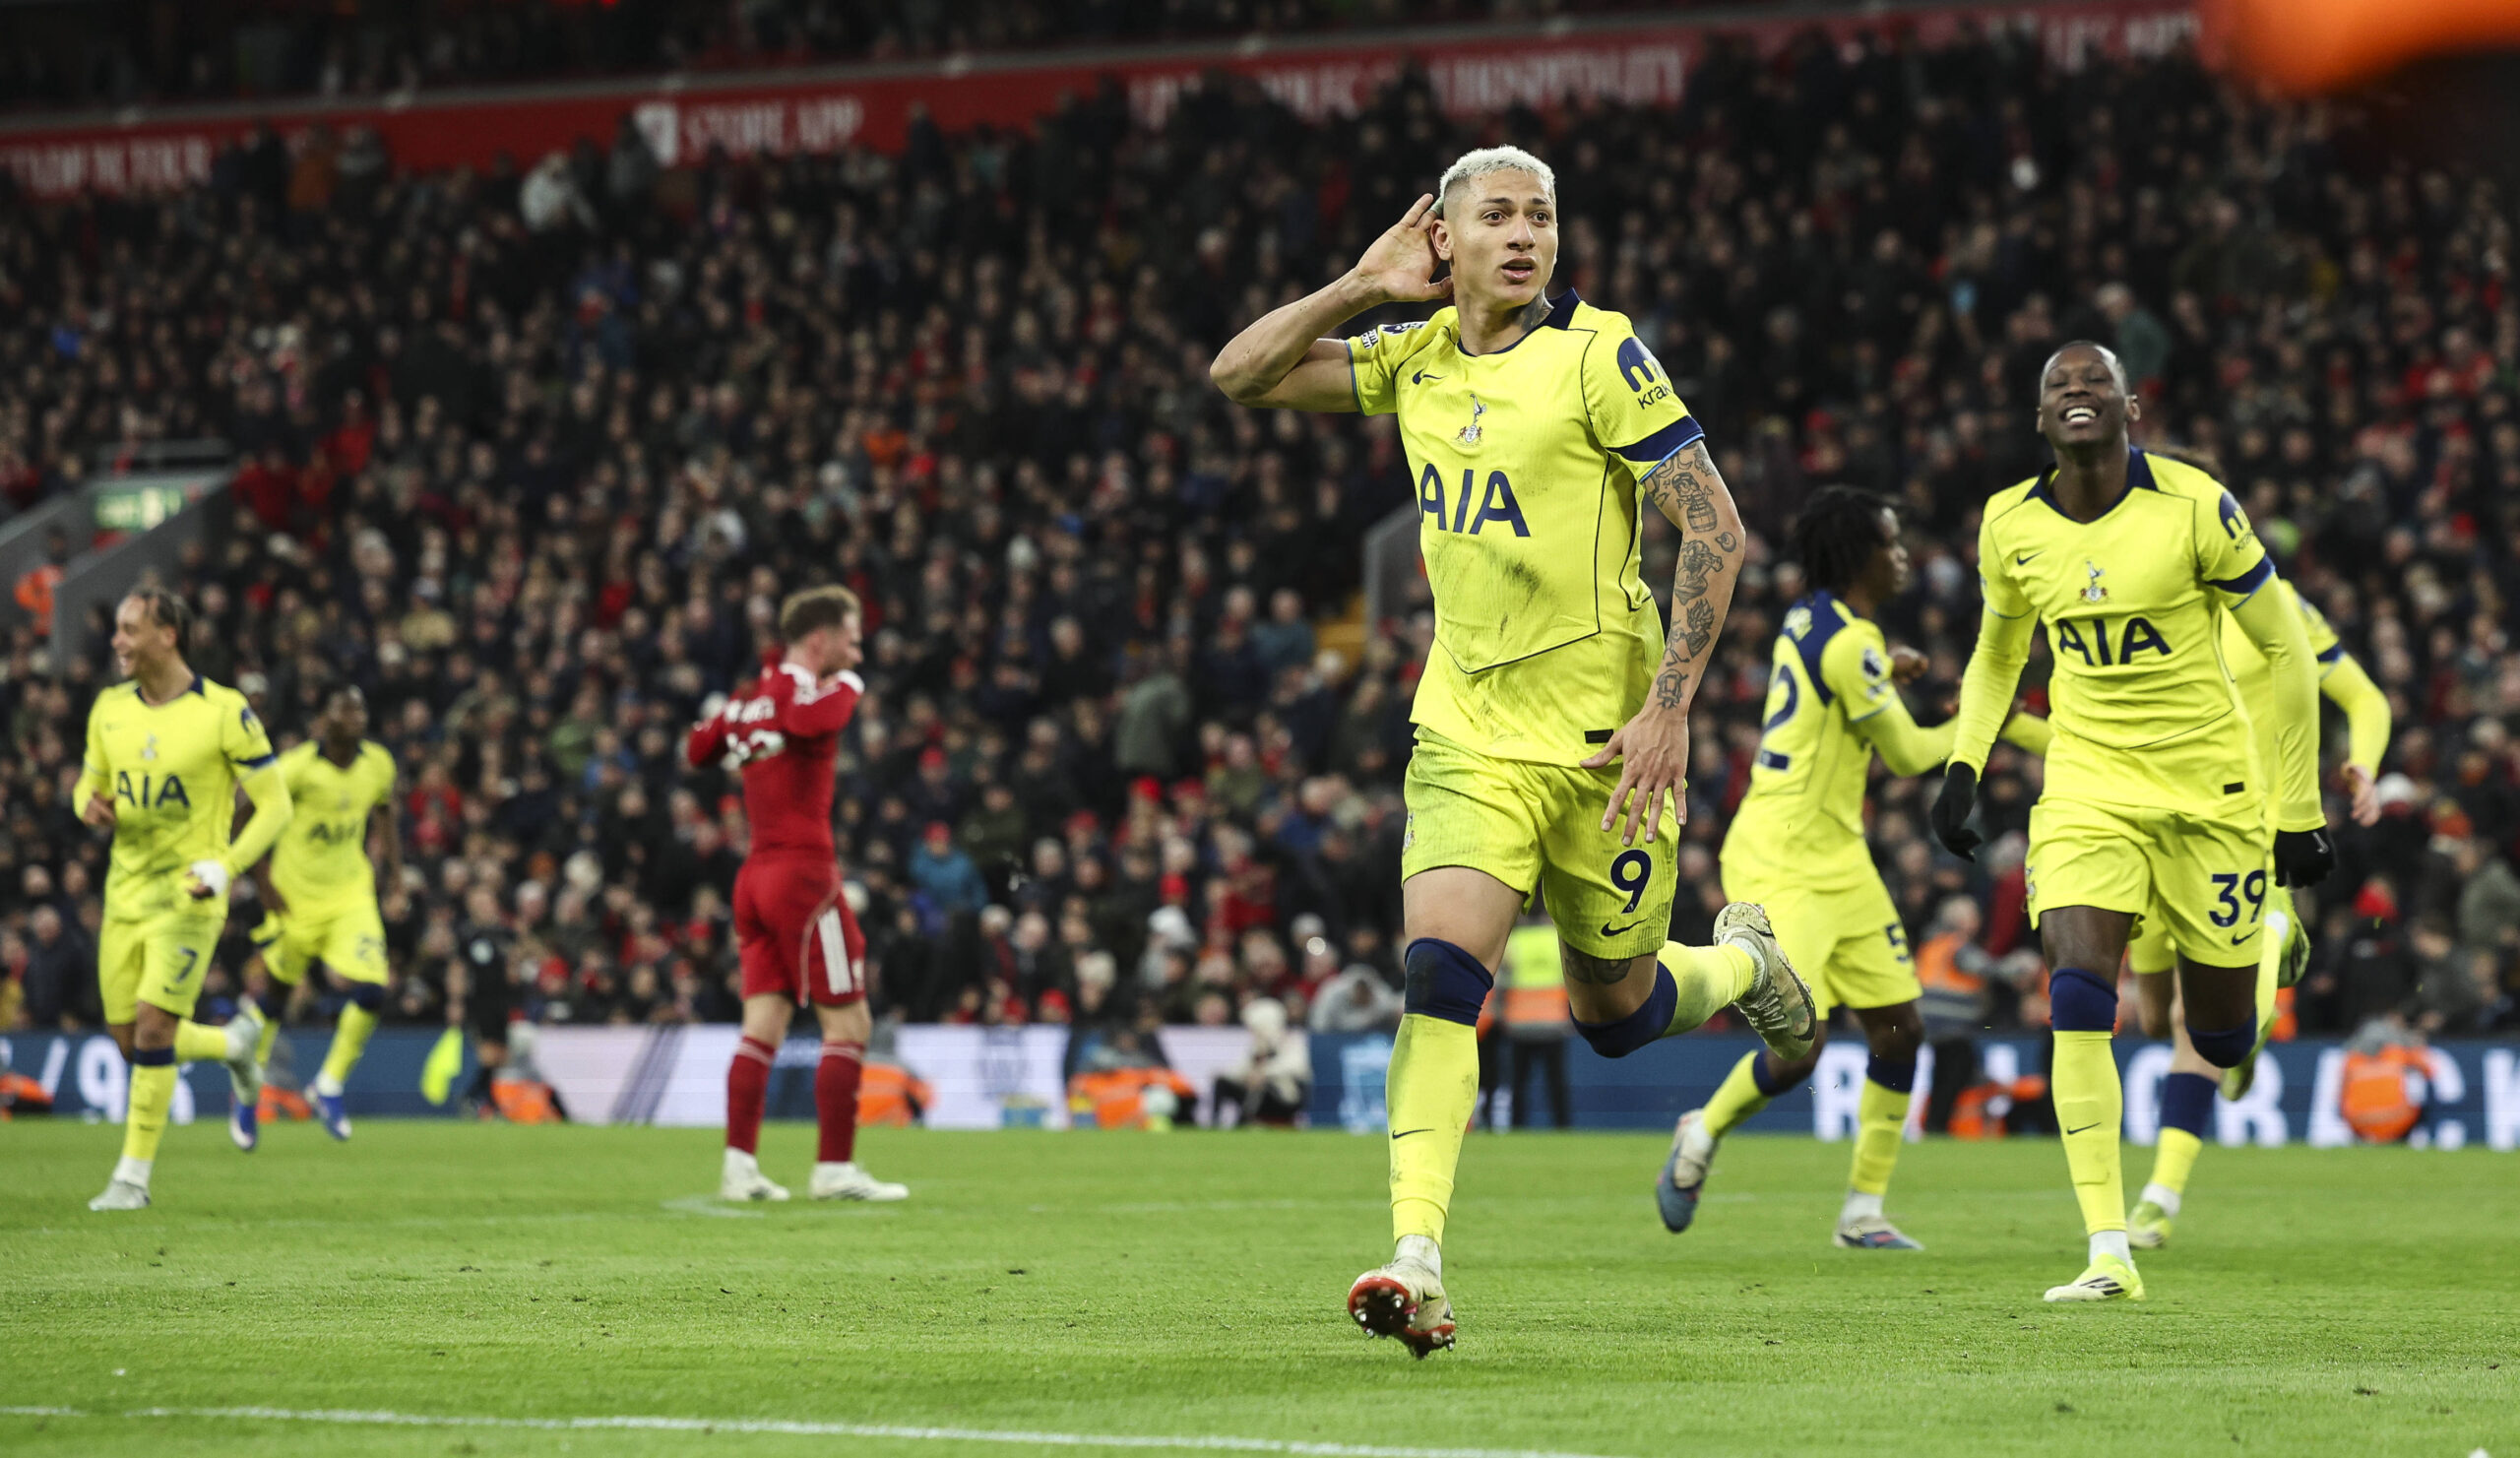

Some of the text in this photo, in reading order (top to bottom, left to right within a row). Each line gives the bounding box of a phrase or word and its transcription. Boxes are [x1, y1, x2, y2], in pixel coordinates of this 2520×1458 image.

[1419, 463, 1531, 538] AIA
[2057, 617, 2174, 666] AIA
[117, 771, 191, 808] AIA
[1610, 849, 1652, 915] 9
[2208, 868, 2267, 928] 39
[179, 946, 199, 983] 7
